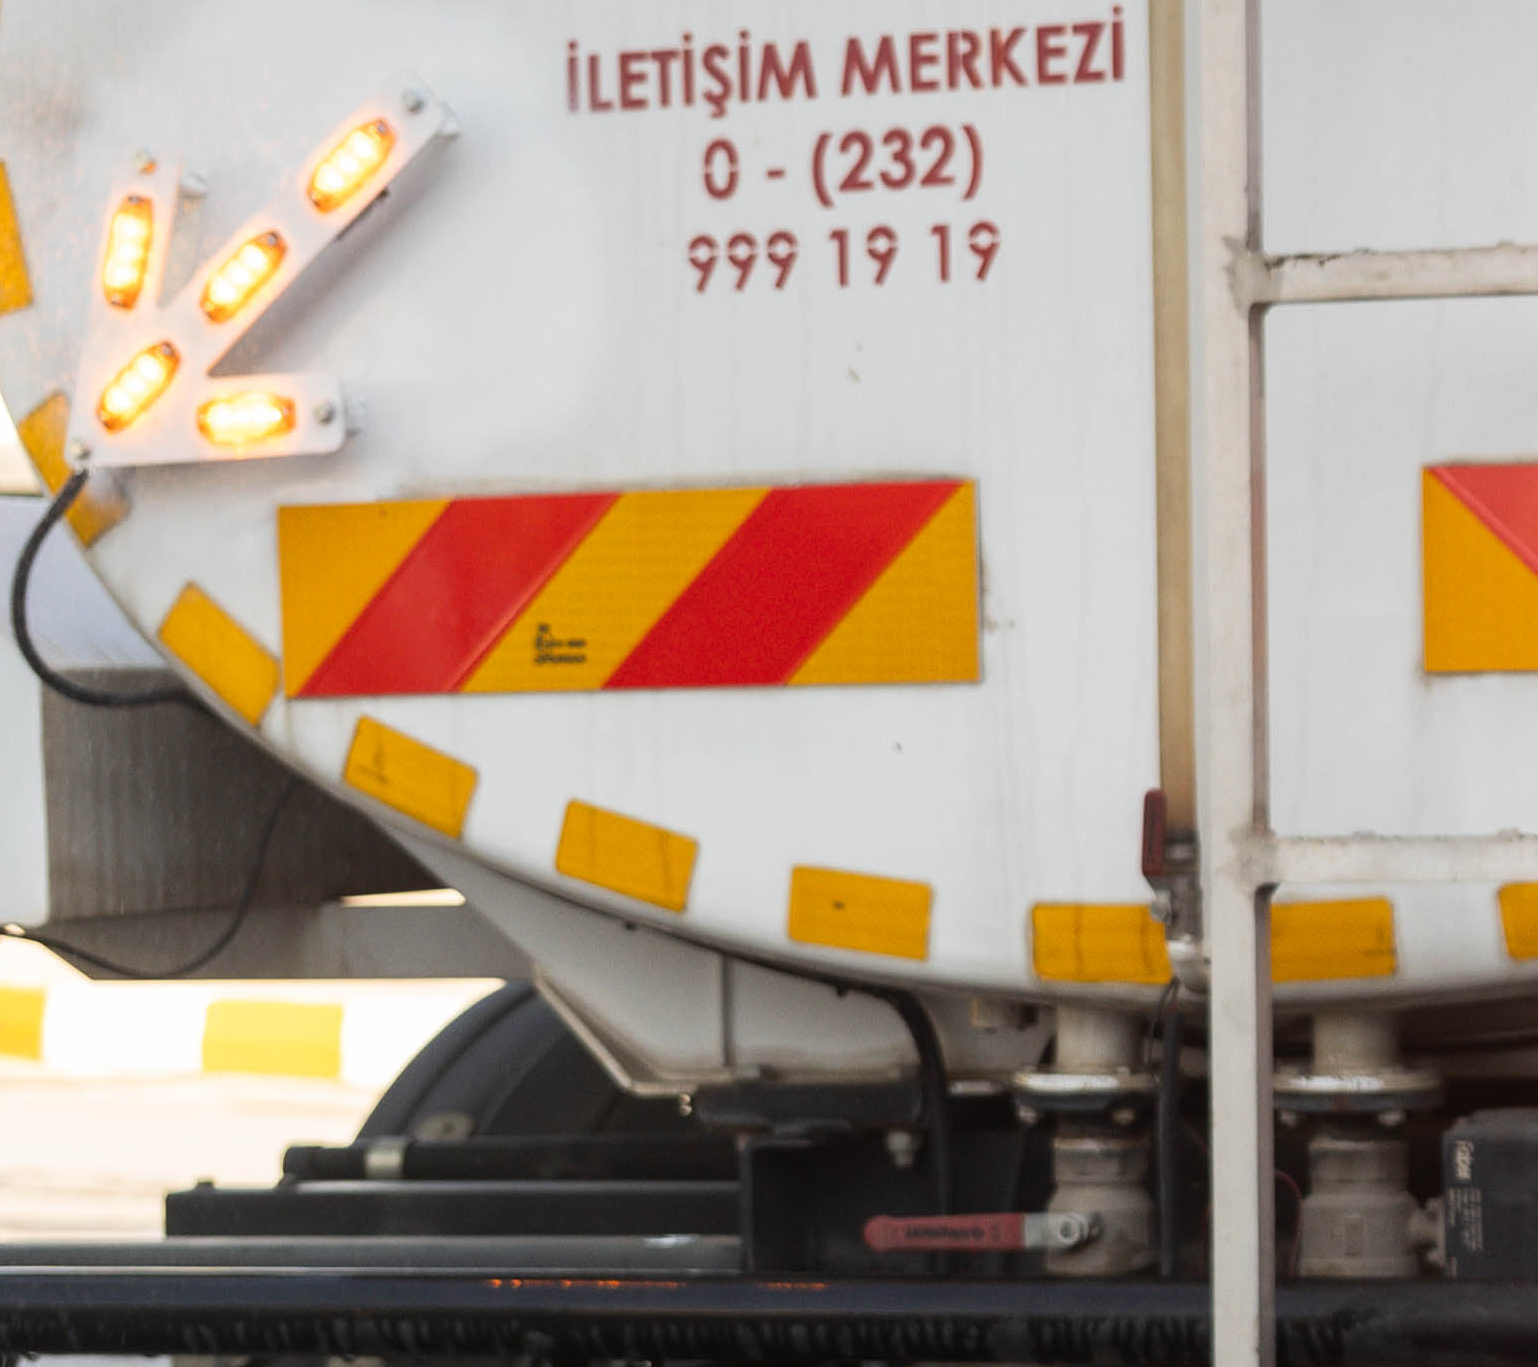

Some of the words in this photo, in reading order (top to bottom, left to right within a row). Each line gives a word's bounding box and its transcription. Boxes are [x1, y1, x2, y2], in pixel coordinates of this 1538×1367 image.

[566, 30, 817, 119] İLETİŞİM
[840, 5, 1125, 97] MERKEZİ
[810, 123, 984, 209] (232)
[687, 230, 798, 294] 999
[829, 224, 898, 288] 19
[930, 219, 1001, 285] 19
